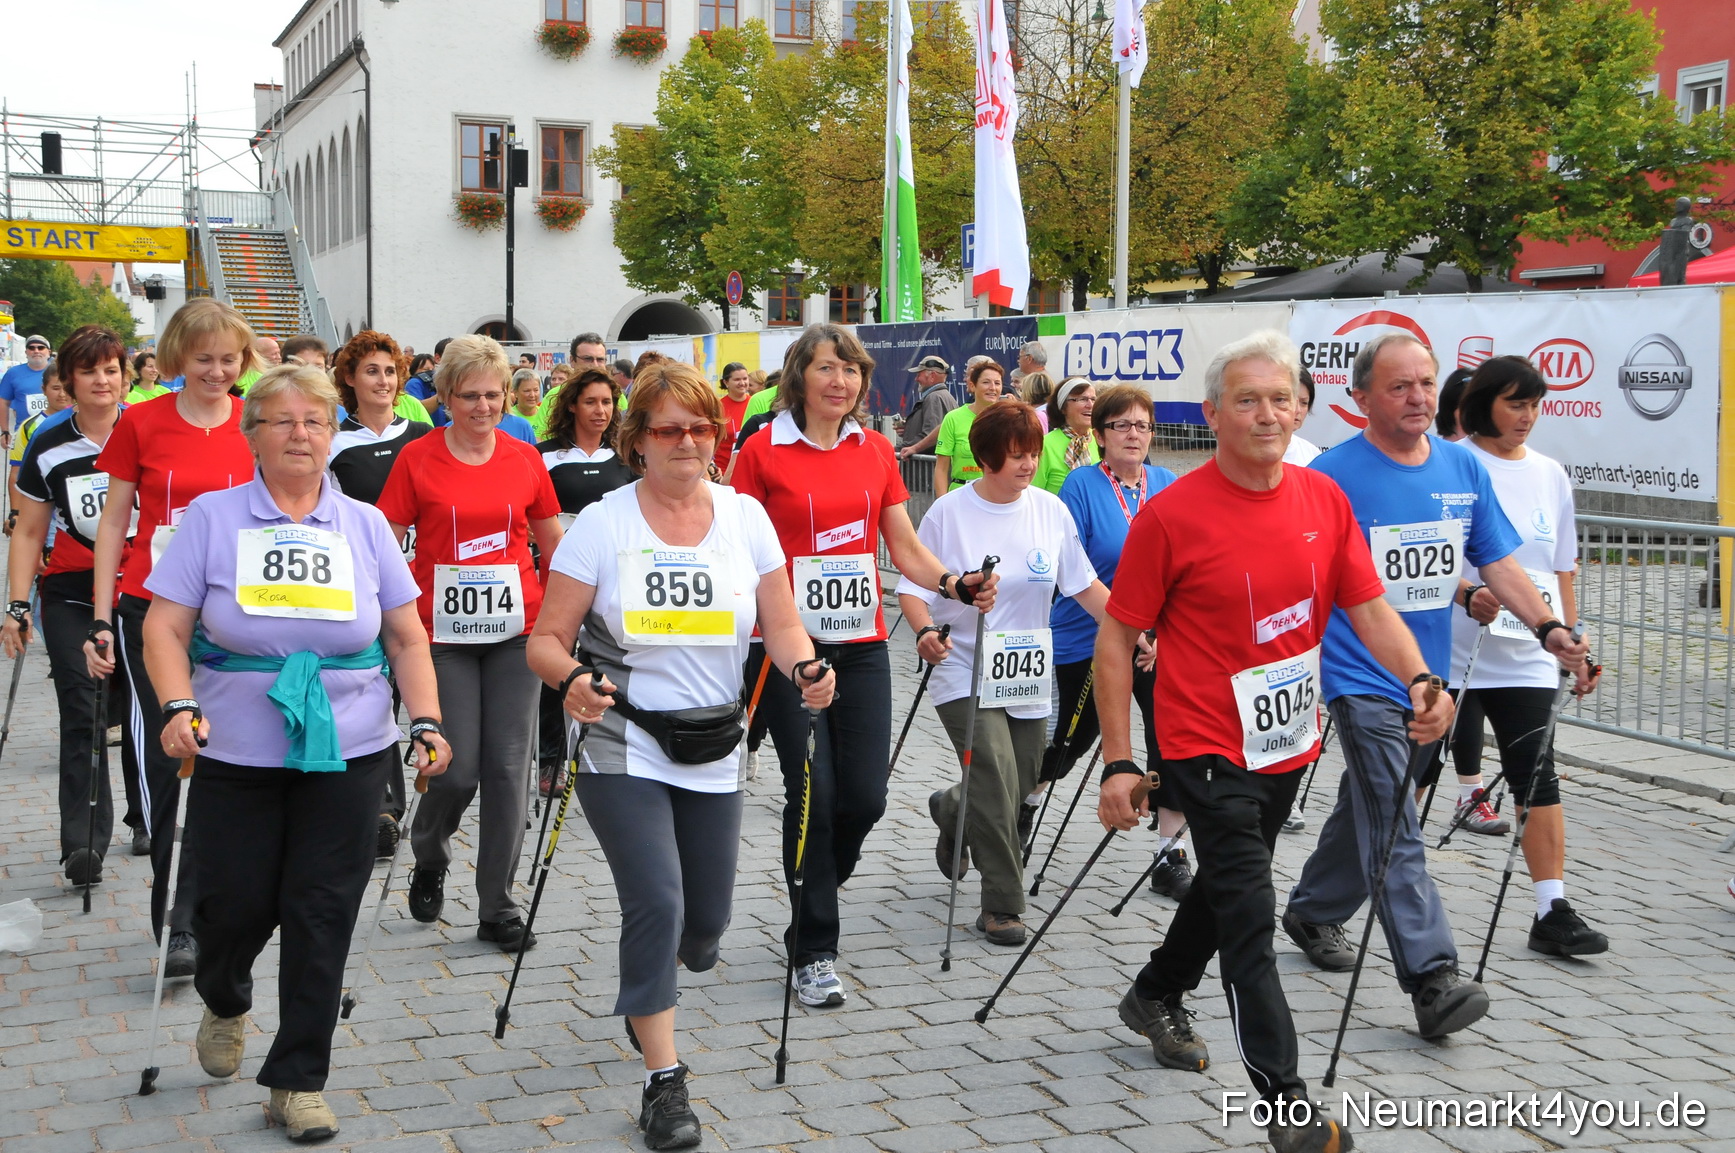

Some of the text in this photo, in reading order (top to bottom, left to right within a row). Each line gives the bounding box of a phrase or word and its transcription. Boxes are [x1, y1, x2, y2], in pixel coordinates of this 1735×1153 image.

[7, 226, 100, 250] START
[1064, 328, 1185, 380] BOCK
[1300, 341, 1360, 369] GERH
[1539, 351, 1583, 378] KIA
[1312, 371, 1348, 385] tohaus
[1624, 370, 1684, 384] NISSAN
[31, 401, 49, 410] 806
[1541, 400, 1602, 418] MOTORS
[1563, 461, 1699, 493] w.gerhart-jaenig.de
[275, 530, 318, 542] BOCK
[830, 529, 852, 542] DEHN
[1400, 528, 1438, 540] BOCK
[472, 539, 493, 552] DEHN
[654, 551, 697, 561] BOCK
[1385, 544, 1455, 581] 8029
[262, 548, 332, 584] 858
[822, 560, 859, 571] BOCK
[459, 570, 495, 579] BOCK
[253, 588, 289, 602] Rosa
[645, 571, 713, 608] 859
[806, 576, 872, 610] 8046
[1406, 586, 1440, 601] Franz
[444, 586, 513, 615] 8014
[452, 620, 506, 634] Gertraud
[641, 616, 673, 630] Maria
[820, 616, 861, 631] Monika
[1272, 611, 1298, 630] DEHN
[1005, 635, 1034, 645] BOCK
[991, 649, 1045, 680] 8043
[1266, 661, 1304, 683] BOCK
[995, 683, 1039, 698] Elisabeth
[1253, 675, 1314, 732] 8045
[1261, 720, 1308, 753] Johannes
